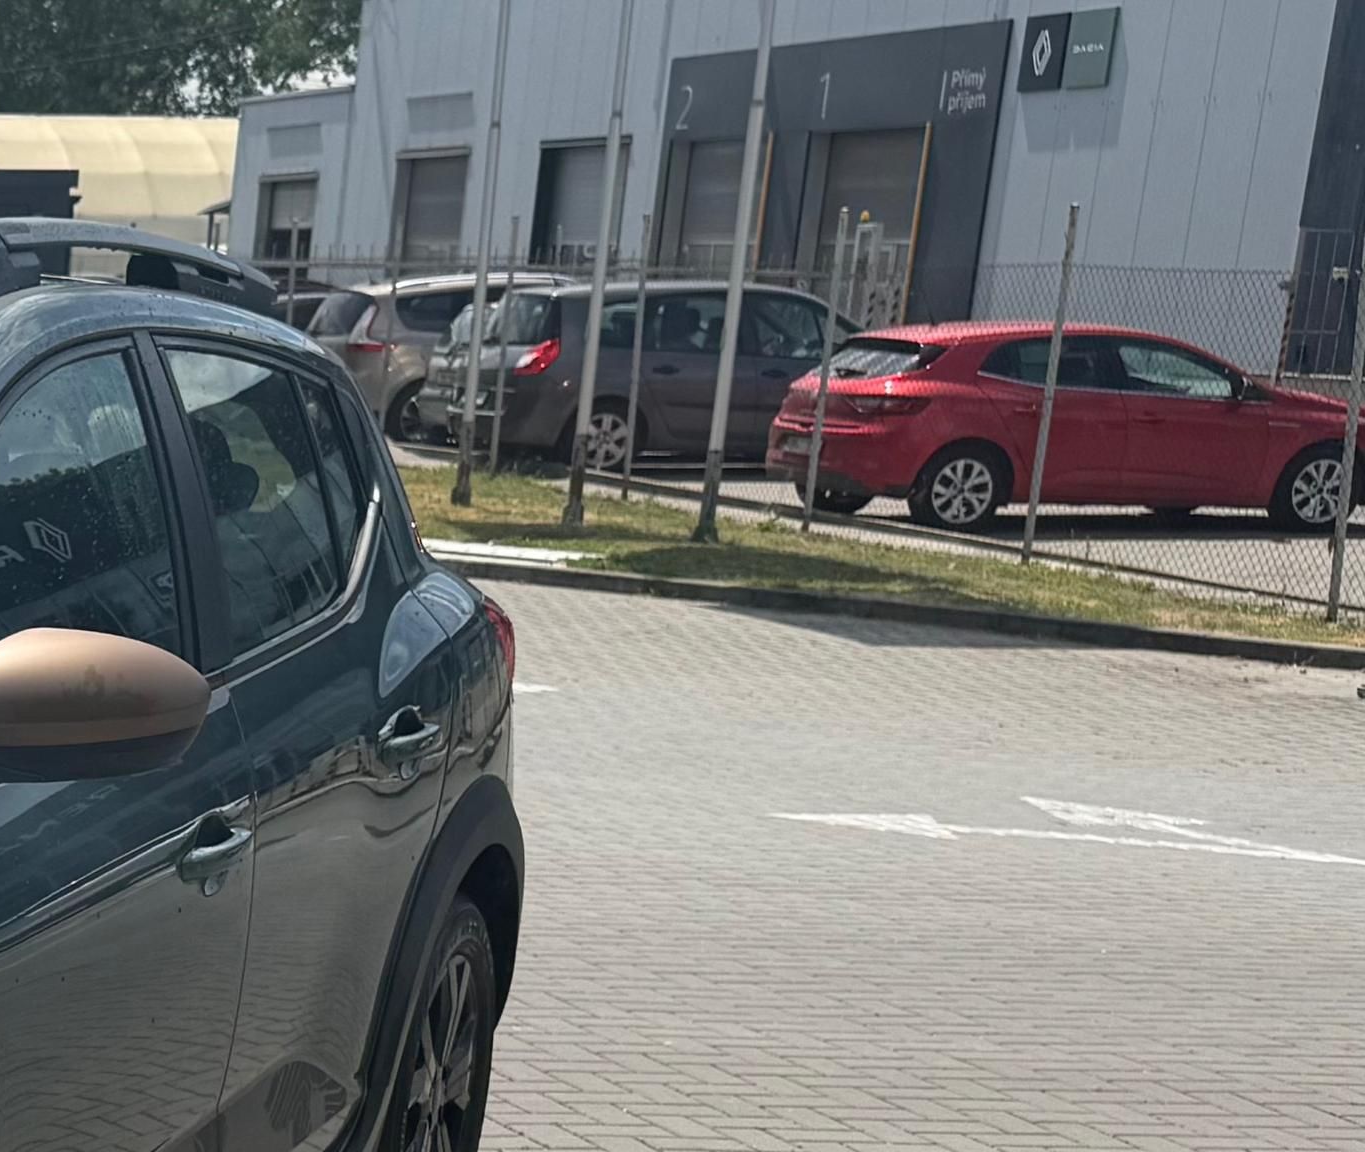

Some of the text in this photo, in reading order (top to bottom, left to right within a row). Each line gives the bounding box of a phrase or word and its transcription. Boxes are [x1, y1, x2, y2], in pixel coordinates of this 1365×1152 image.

[951, 67, 986, 90] Přímý
[675, 85, 693, 130] 2
[820, 72, 830, 120] 1
[947, 91, 986, 115] příjem
